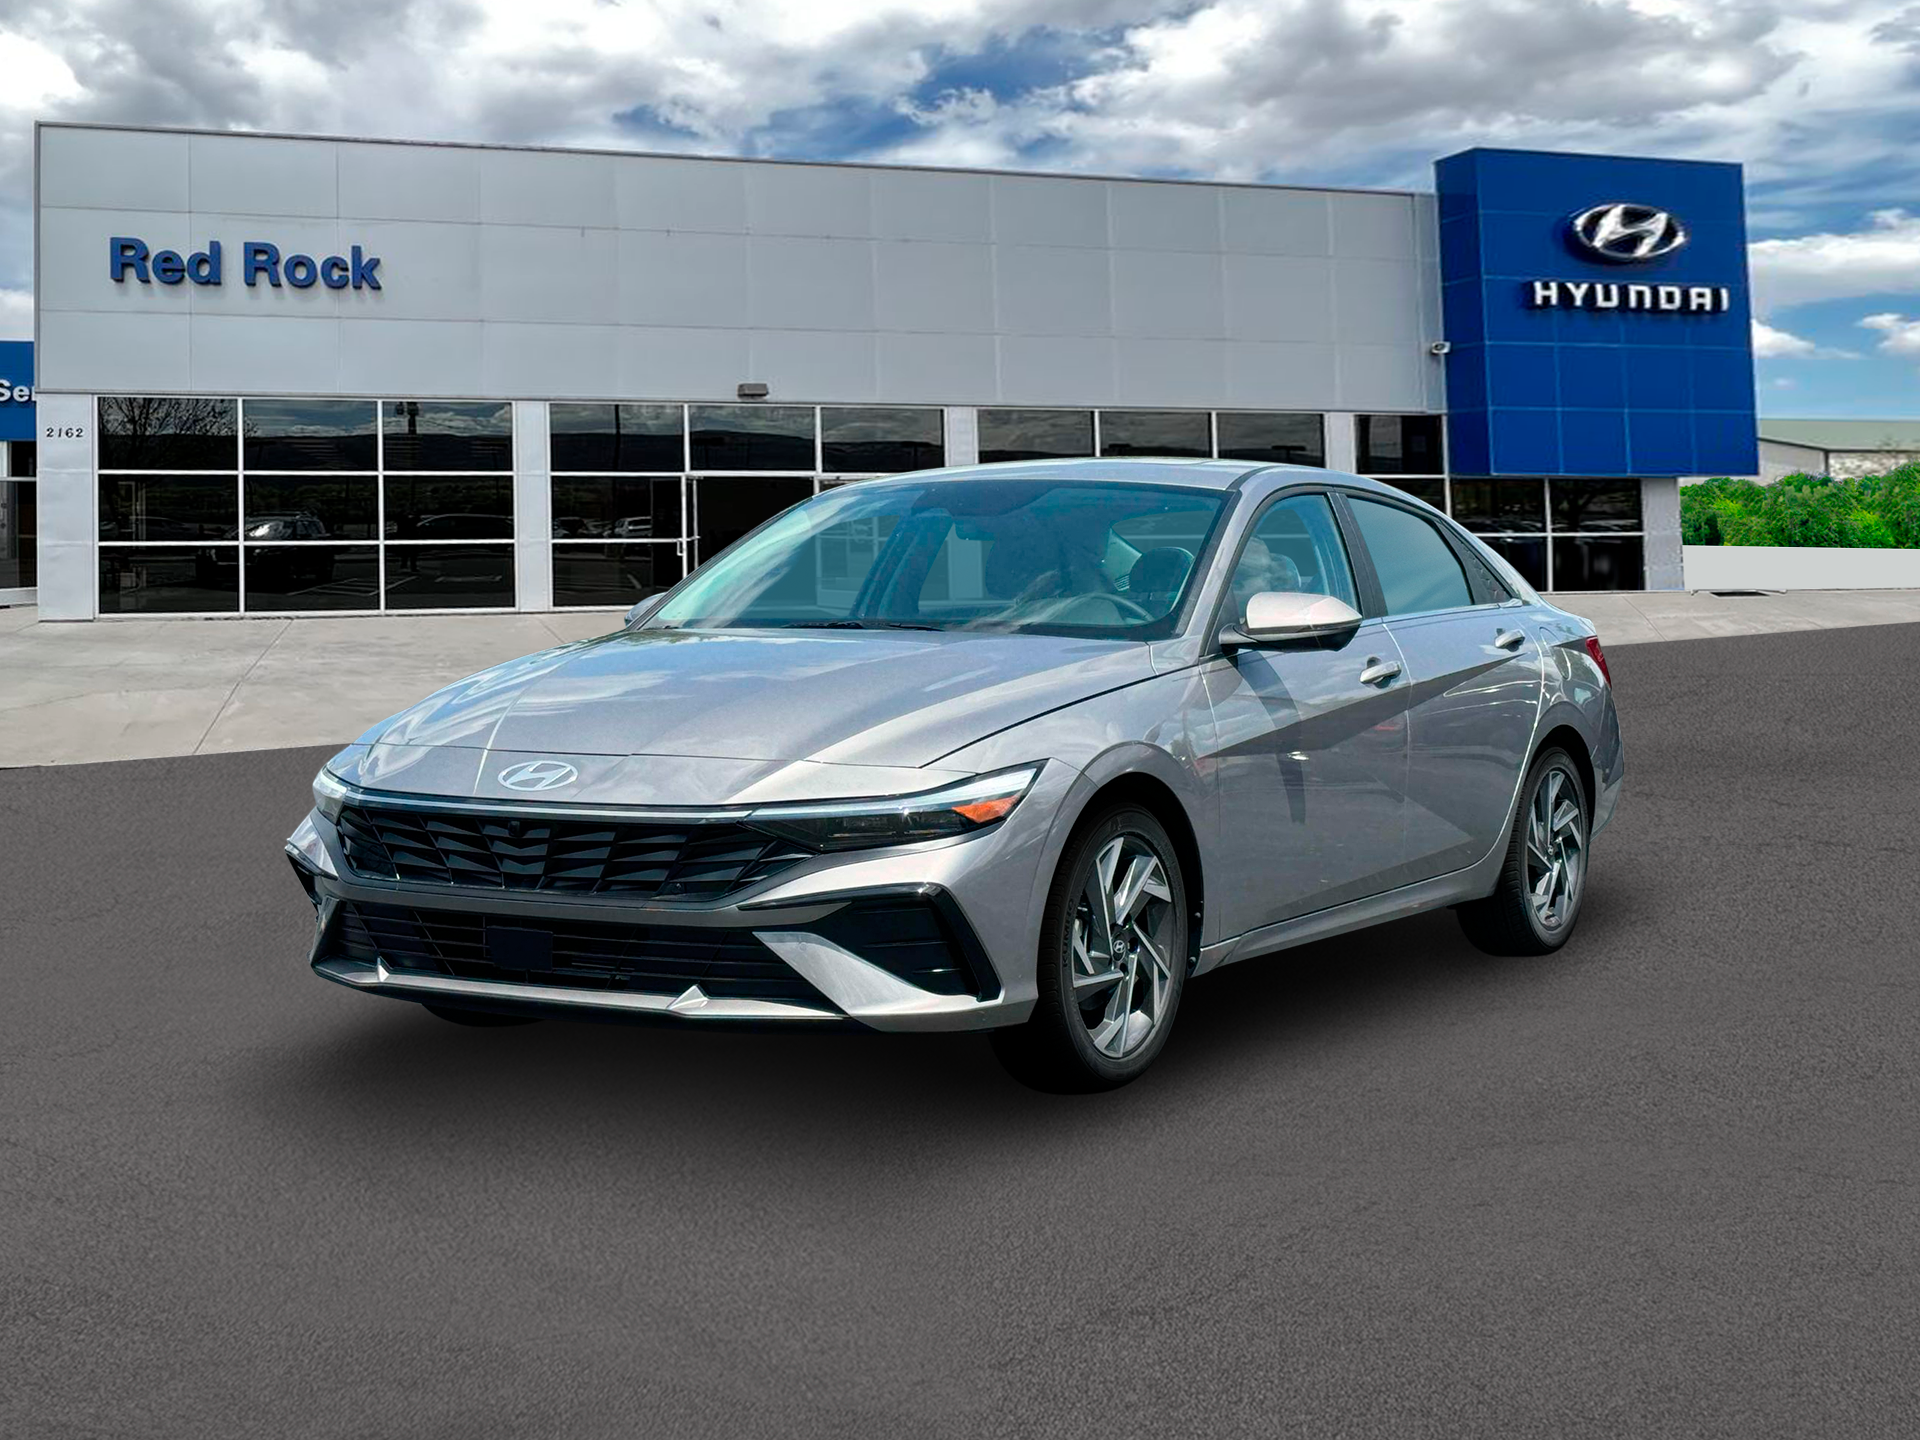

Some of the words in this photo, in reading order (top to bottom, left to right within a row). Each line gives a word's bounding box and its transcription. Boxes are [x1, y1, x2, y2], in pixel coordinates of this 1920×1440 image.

[110, 237, 221, 285] Red
[243, 242, 382, 290] Rock
[1534, 281, 1729, 311] HYUNDAI
[46, 427, 84, 438] 2162
